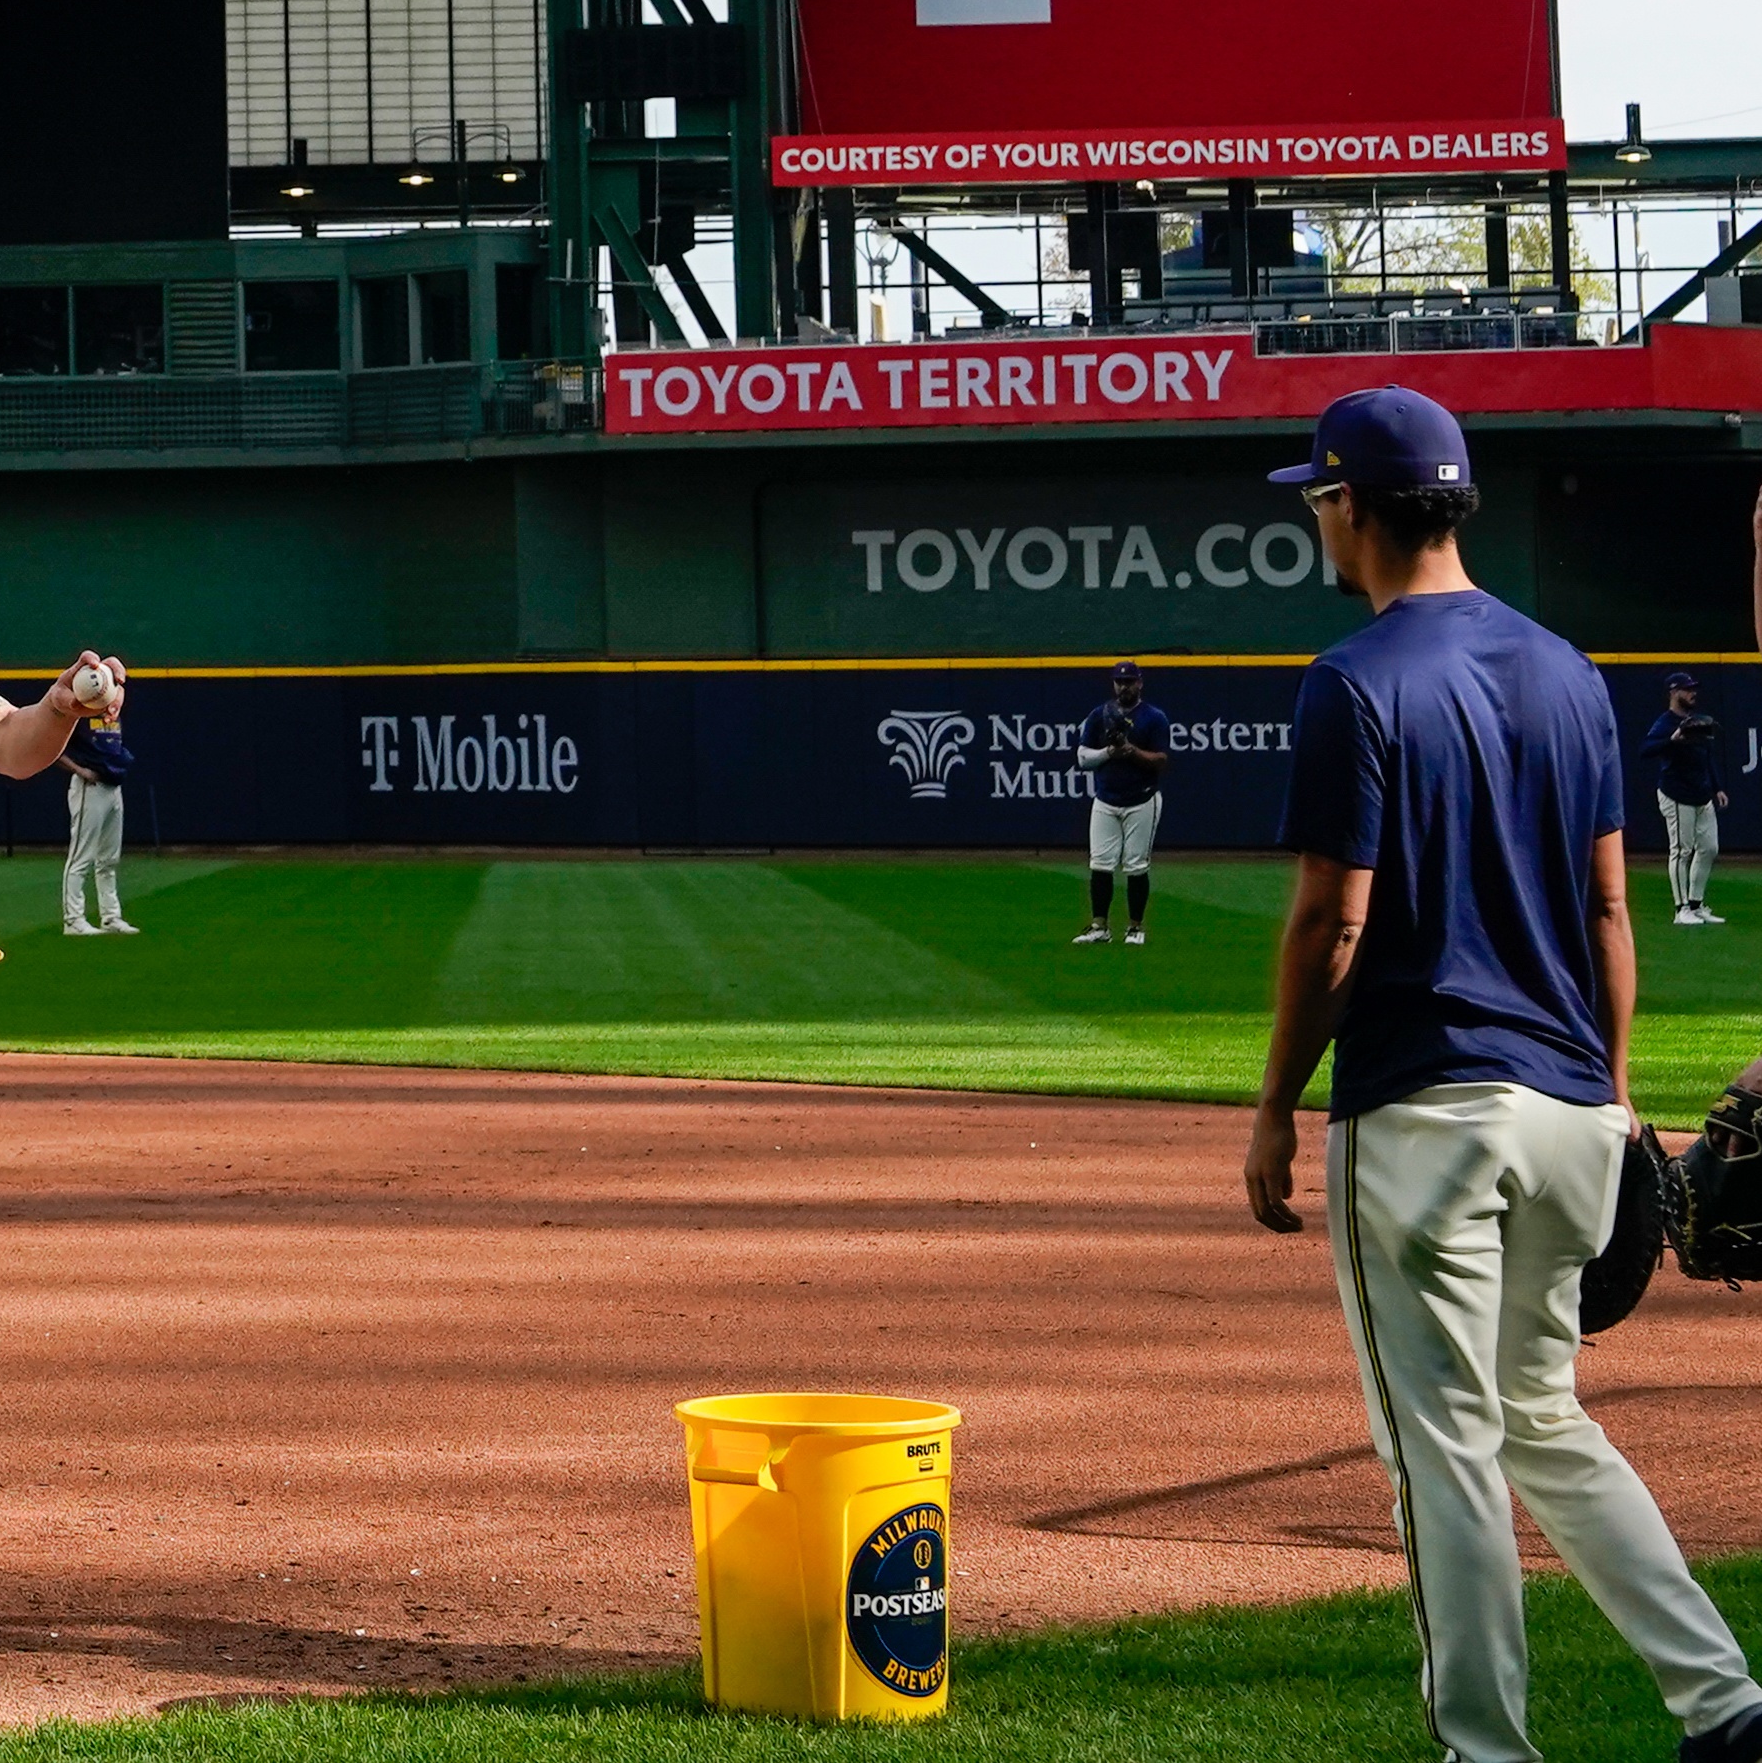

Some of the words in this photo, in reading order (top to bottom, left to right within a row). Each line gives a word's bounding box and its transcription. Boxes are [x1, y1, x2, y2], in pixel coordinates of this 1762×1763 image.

[780, 145, 938, 172] COURTESY
[944, 144, 986, 169] OF
[991, 142, 1079, 169] YOUR
[1085, 138, 1269, 166] WISCONSIN
[1276, 135, 1401, 163] TOYOTA
[1408, 131, 1549, 160] DEALERS
[619, 361, 863, 418] TOYOTA
[878, 349, 1234, 410] TERRITORY
[411, 714, 579, 793] Mobile
[907, 1442, 941, 1458] BRUTE
